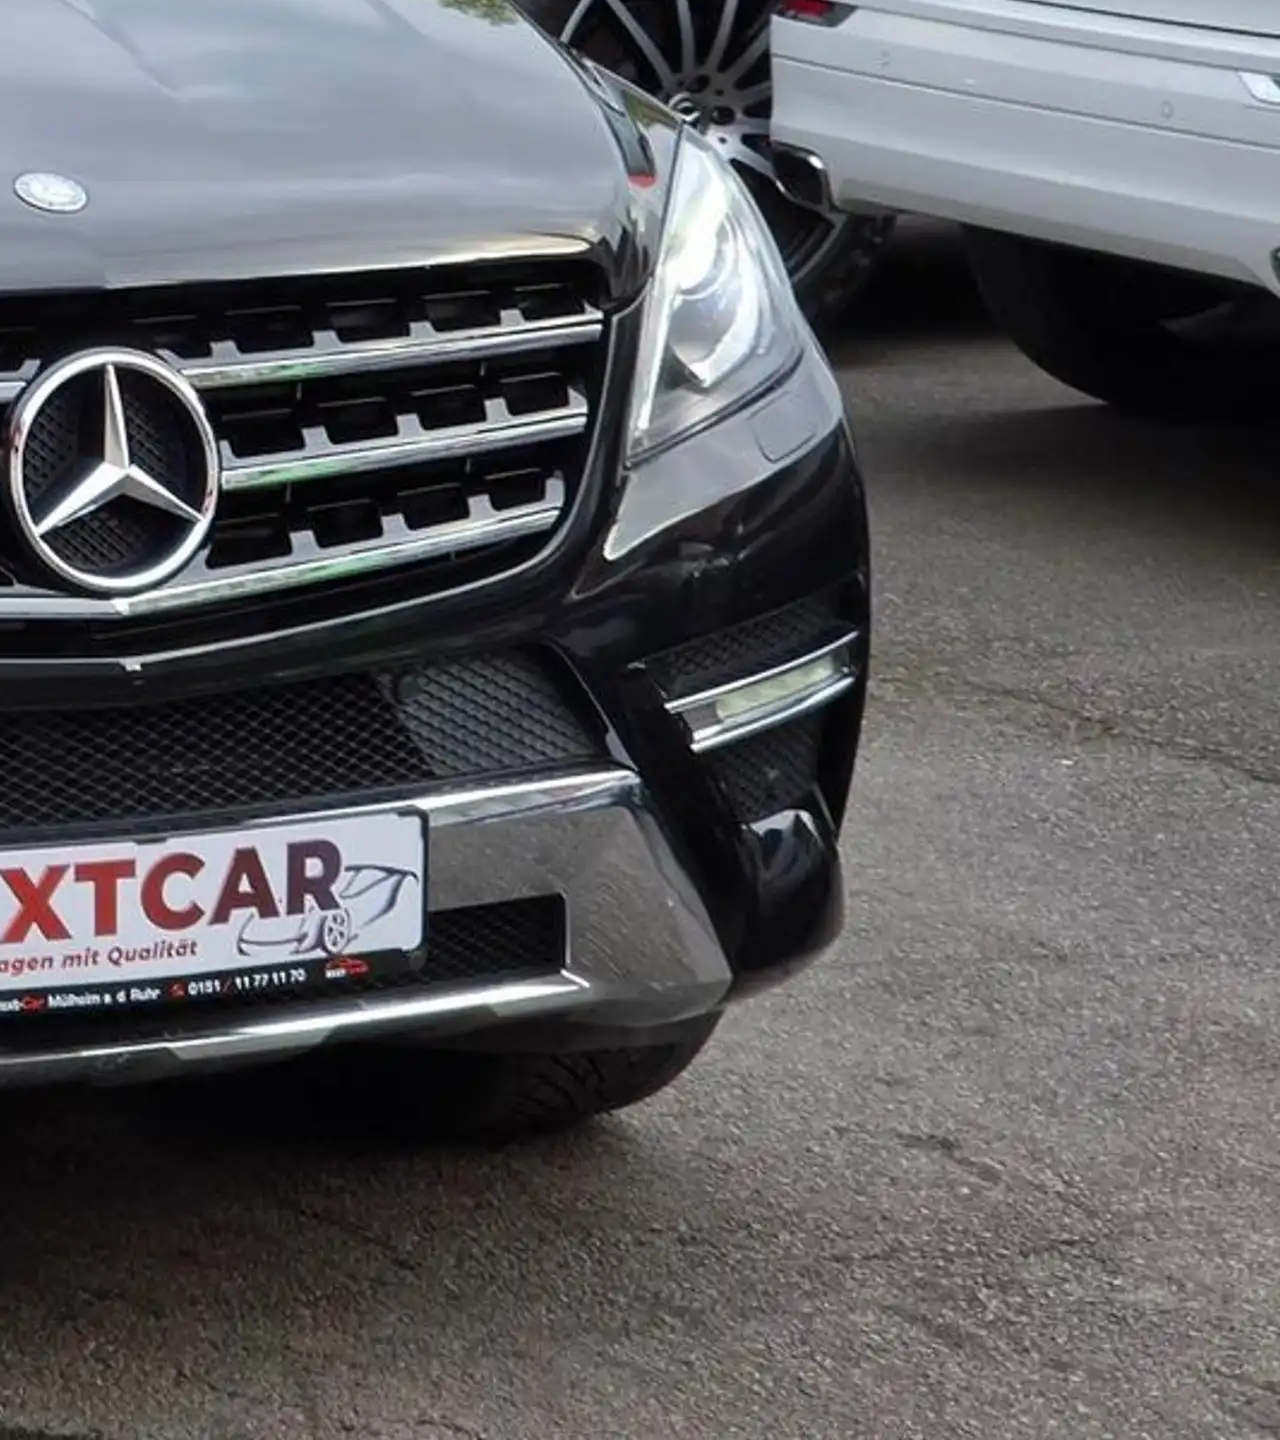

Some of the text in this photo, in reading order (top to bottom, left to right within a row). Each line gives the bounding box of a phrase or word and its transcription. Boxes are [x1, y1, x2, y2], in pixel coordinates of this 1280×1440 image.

[61, 946, 100, 969] mit
[107, 939, 199, 967] Qualität
[253, 972, 269, 987] 77
